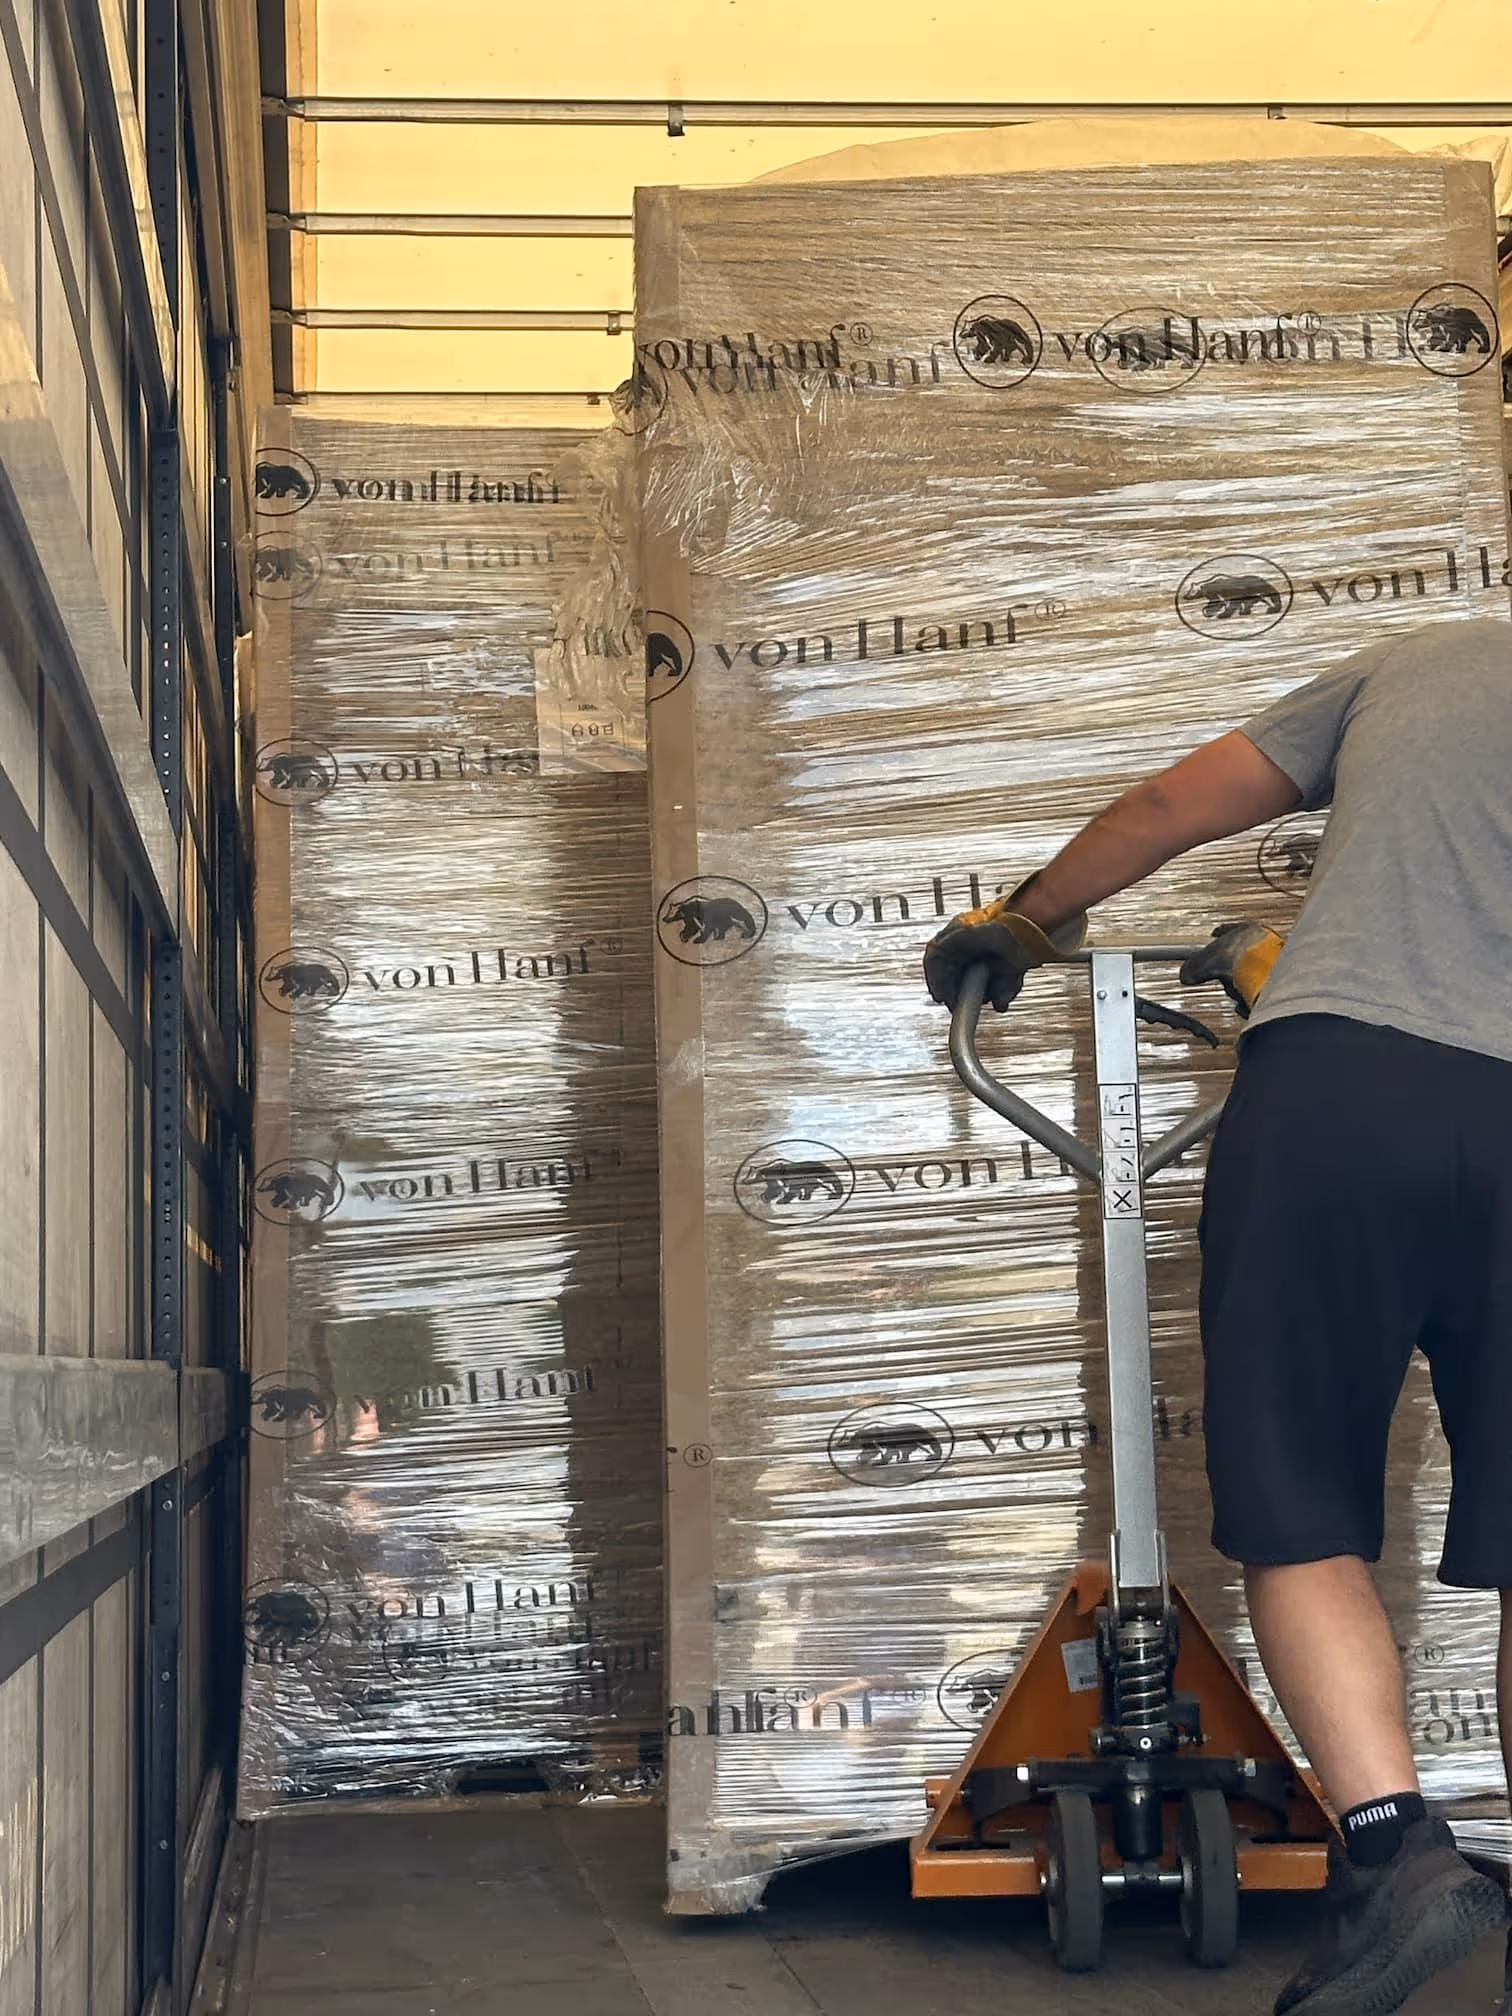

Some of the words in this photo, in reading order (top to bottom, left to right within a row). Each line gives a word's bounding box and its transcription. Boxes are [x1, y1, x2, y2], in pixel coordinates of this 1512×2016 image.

[1311, 569, 1427, 606] von
[711, 631, 835, 671] von
[350, 757, 442, 785] von
[786, 890, 910, 931] von
[361, 964, 457, 993] von
[357, 1169, 455, 1203] von
[873, 1154, 999, 1194] von
[347, 1590, 446, 1622] von
[1347, 1801, 1399, 1832] PUMA
